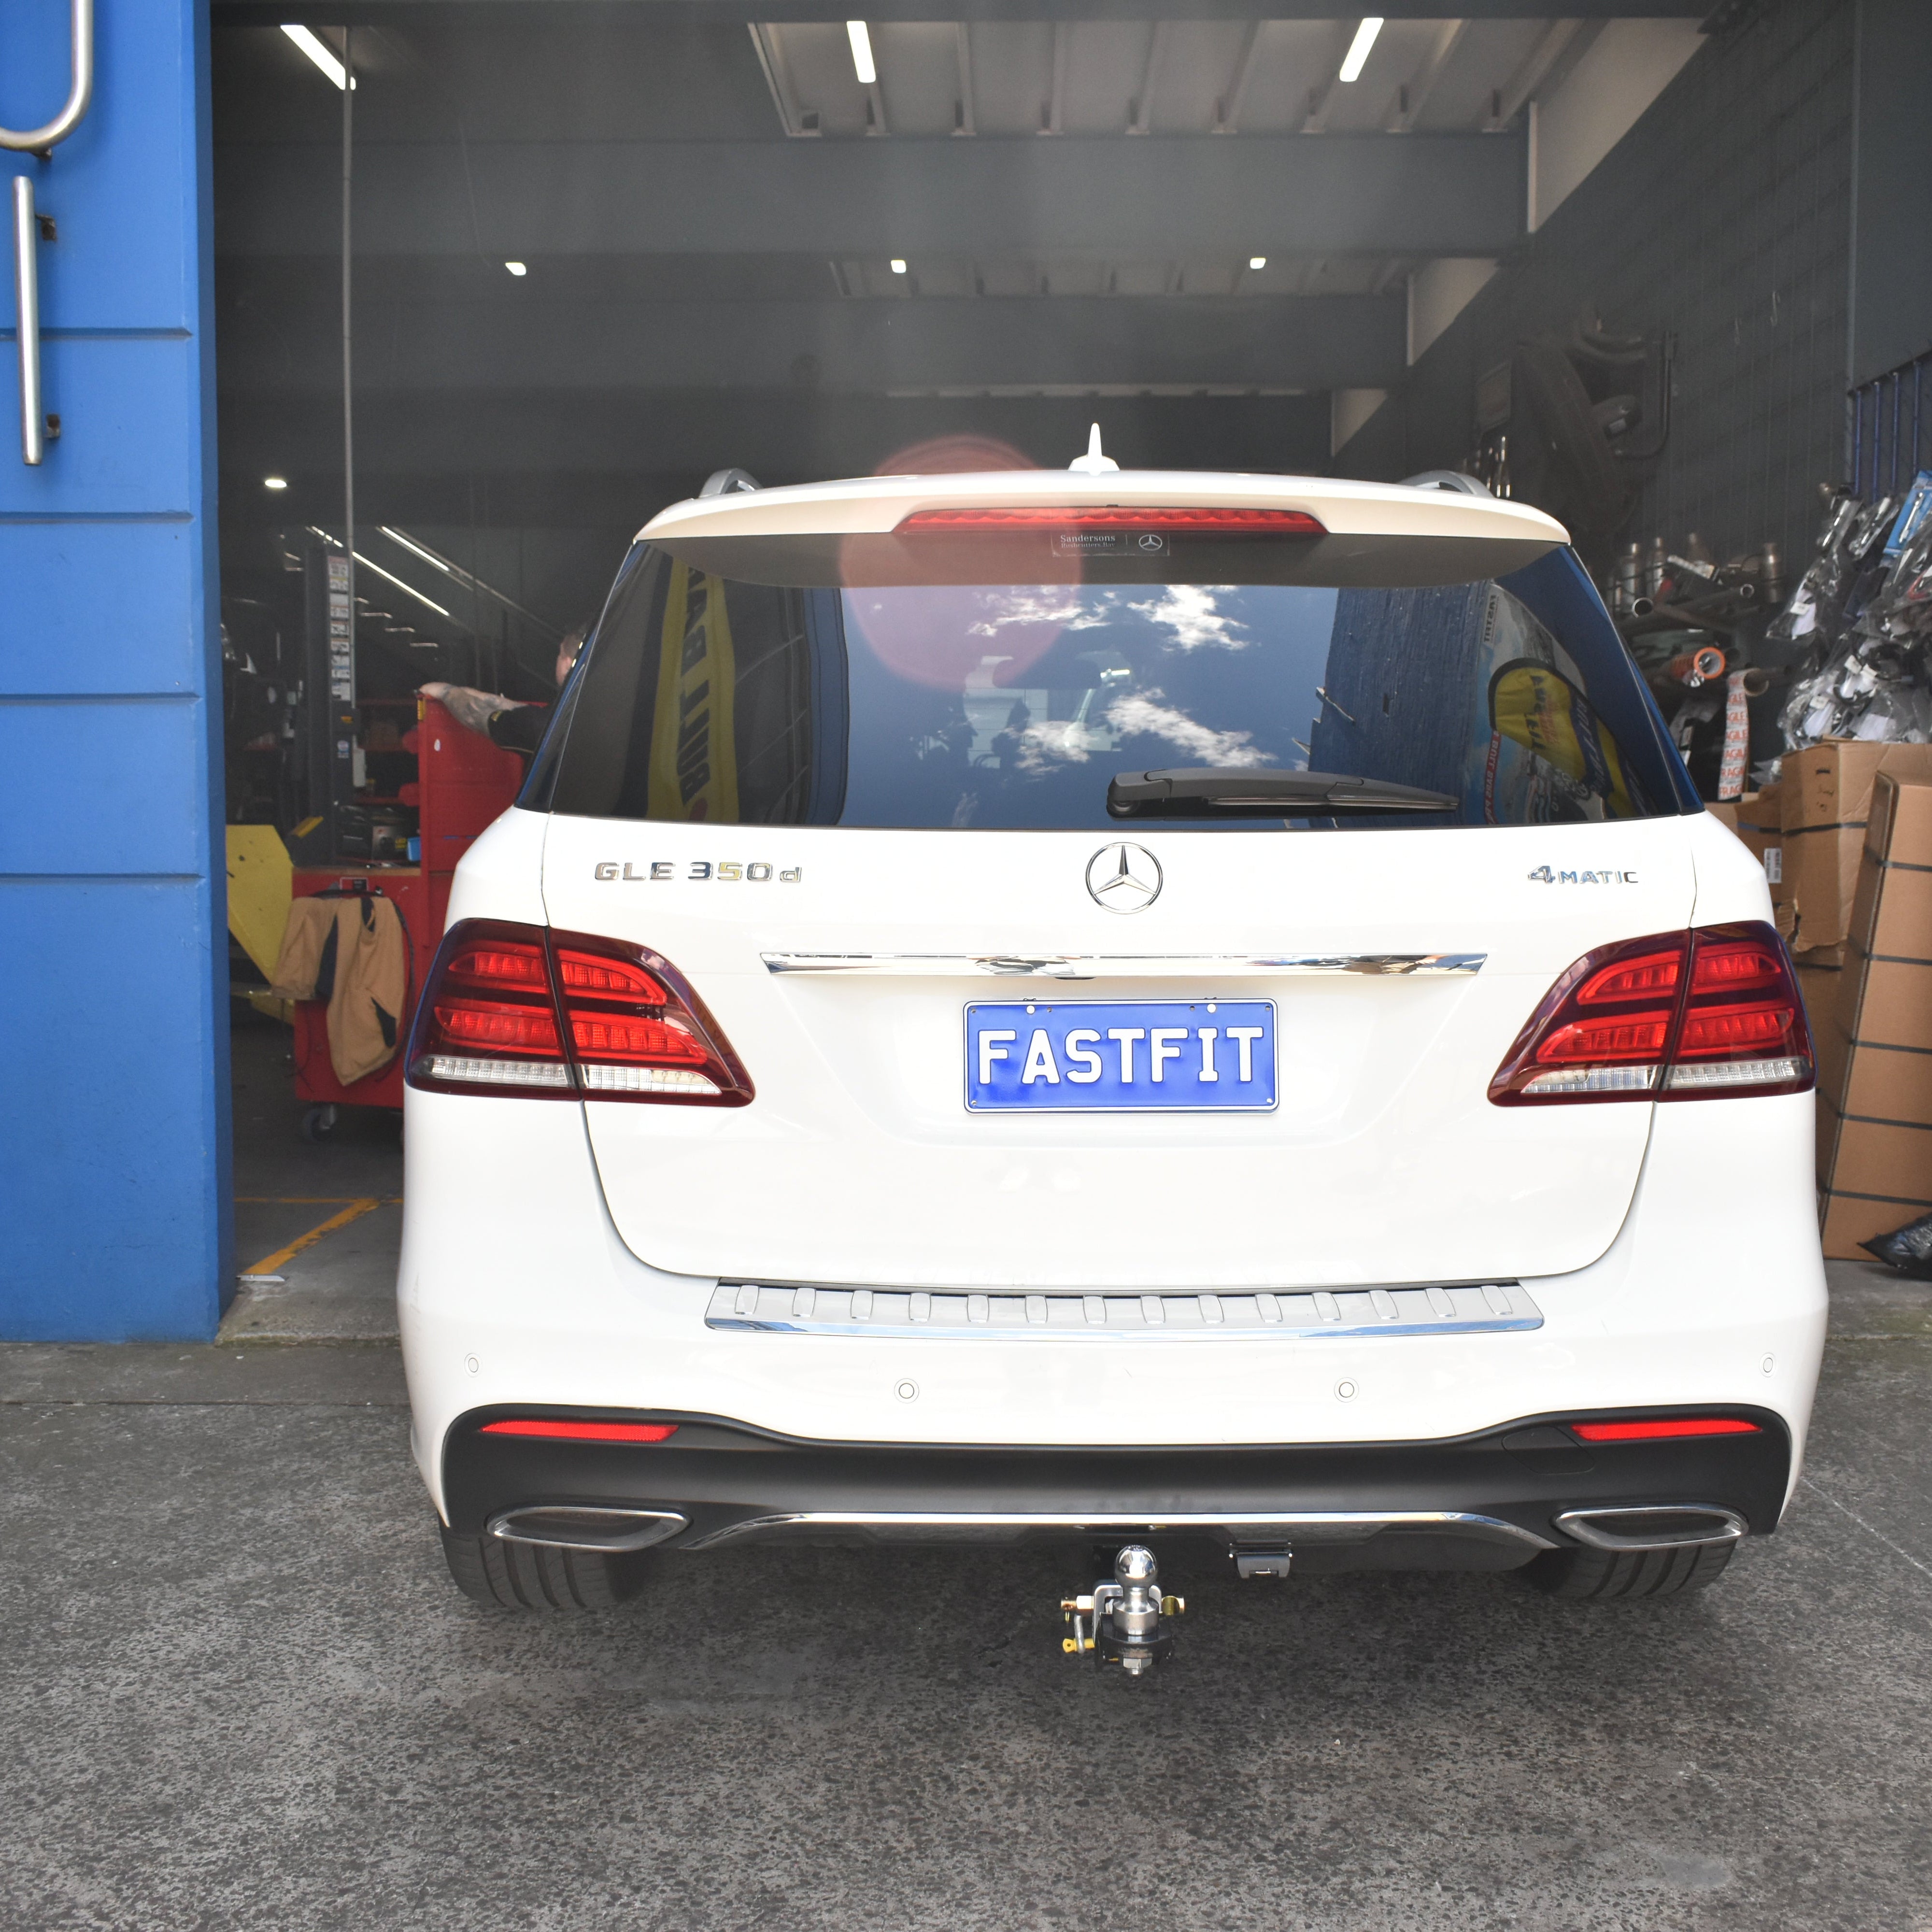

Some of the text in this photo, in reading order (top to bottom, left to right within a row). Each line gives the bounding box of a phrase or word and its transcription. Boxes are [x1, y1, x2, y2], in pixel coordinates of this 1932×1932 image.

[1061, 534, 1115, 542] Sandersons
[595, 862, 676, 881] GLE
[1527, 866, 1639, 884] 4MATIC
[978, 1026, 1264, 1084] FASTFIT
